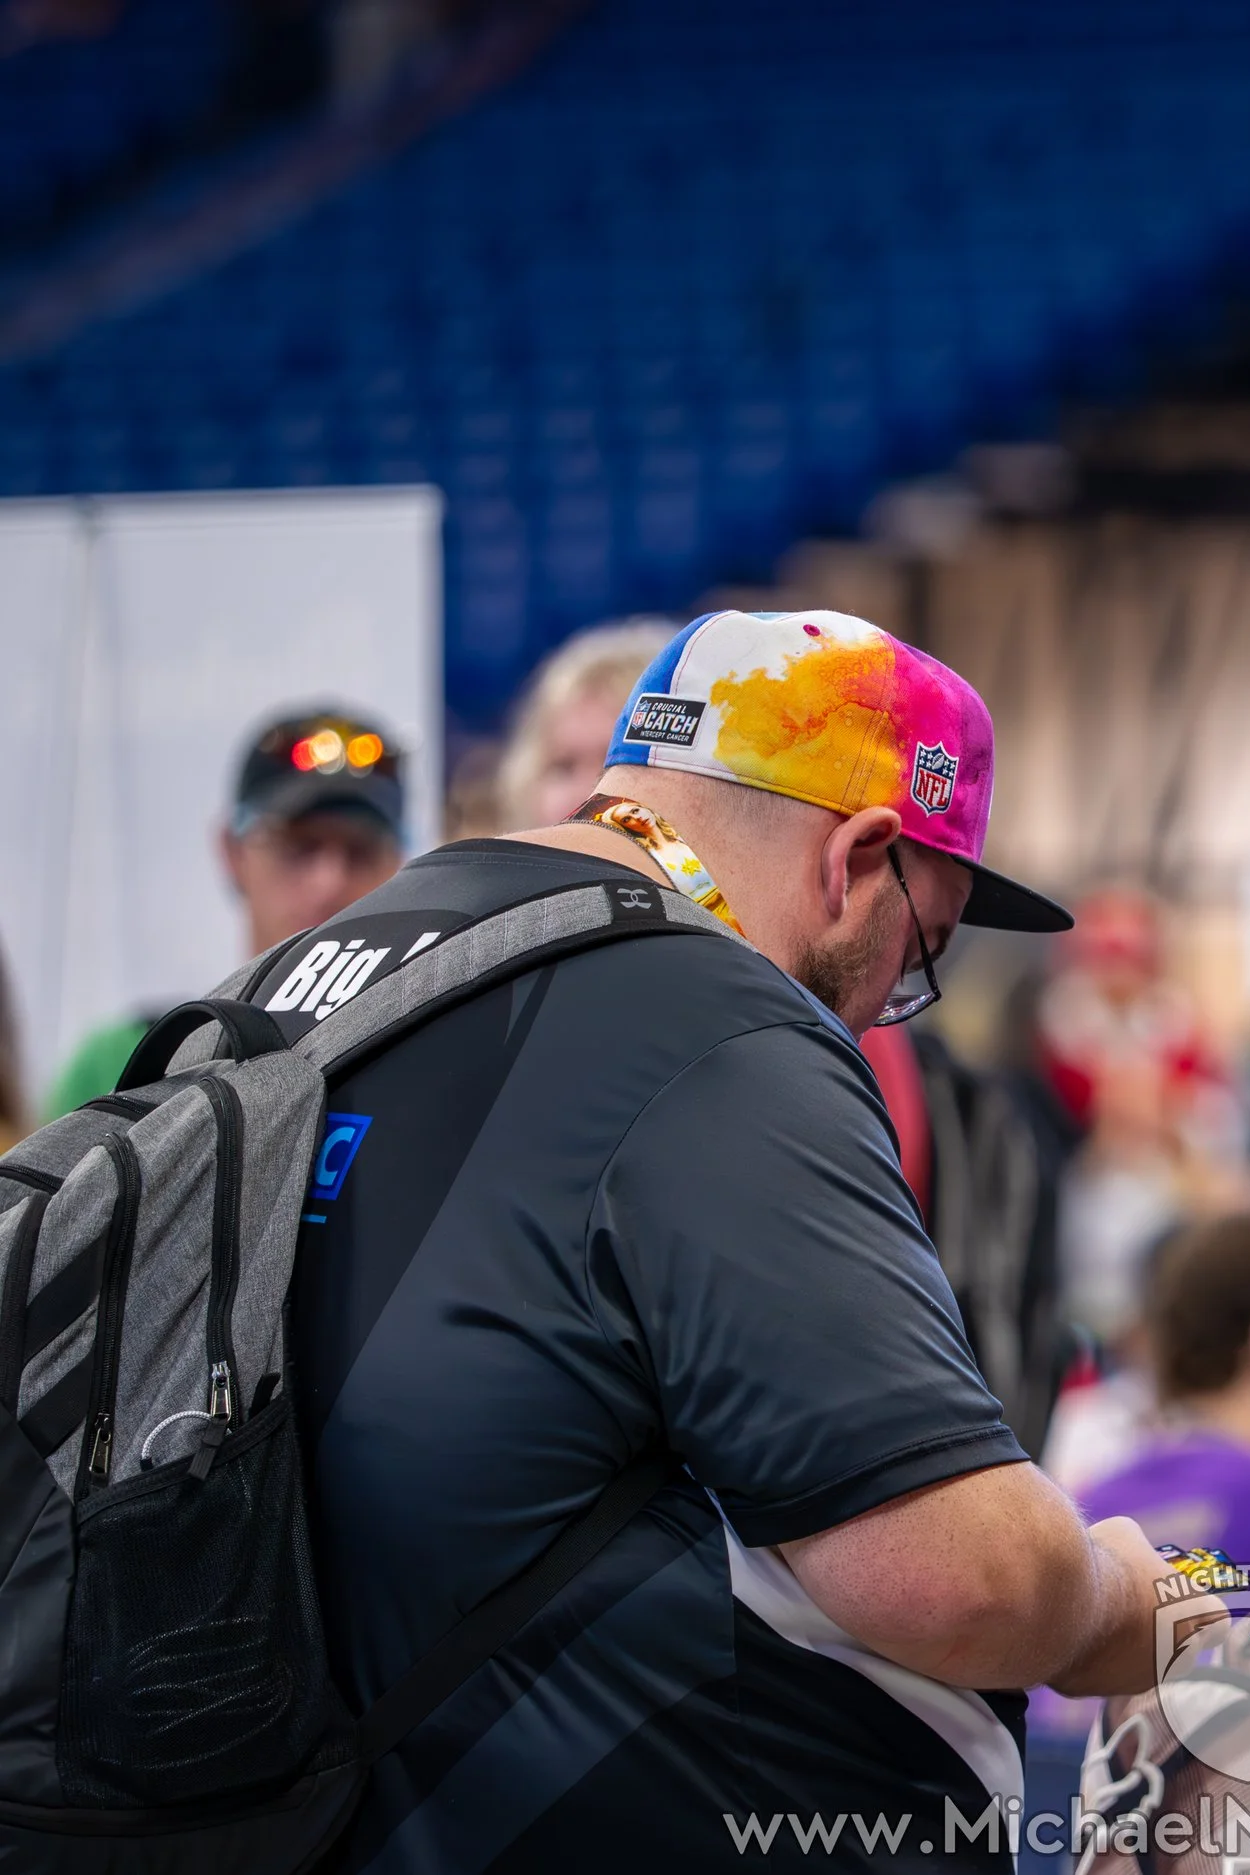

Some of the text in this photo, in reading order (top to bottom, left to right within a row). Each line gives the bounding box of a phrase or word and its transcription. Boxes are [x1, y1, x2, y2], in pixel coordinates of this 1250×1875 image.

[652, 703, 687, 714] CRUCIAL
[644, 711, 699, 734] CATCH
[640, 730, 690, 742] INTERCEPT CANCER
[916, 768, 948, 807] NFL
[264, 938, 391, 1021] Big
